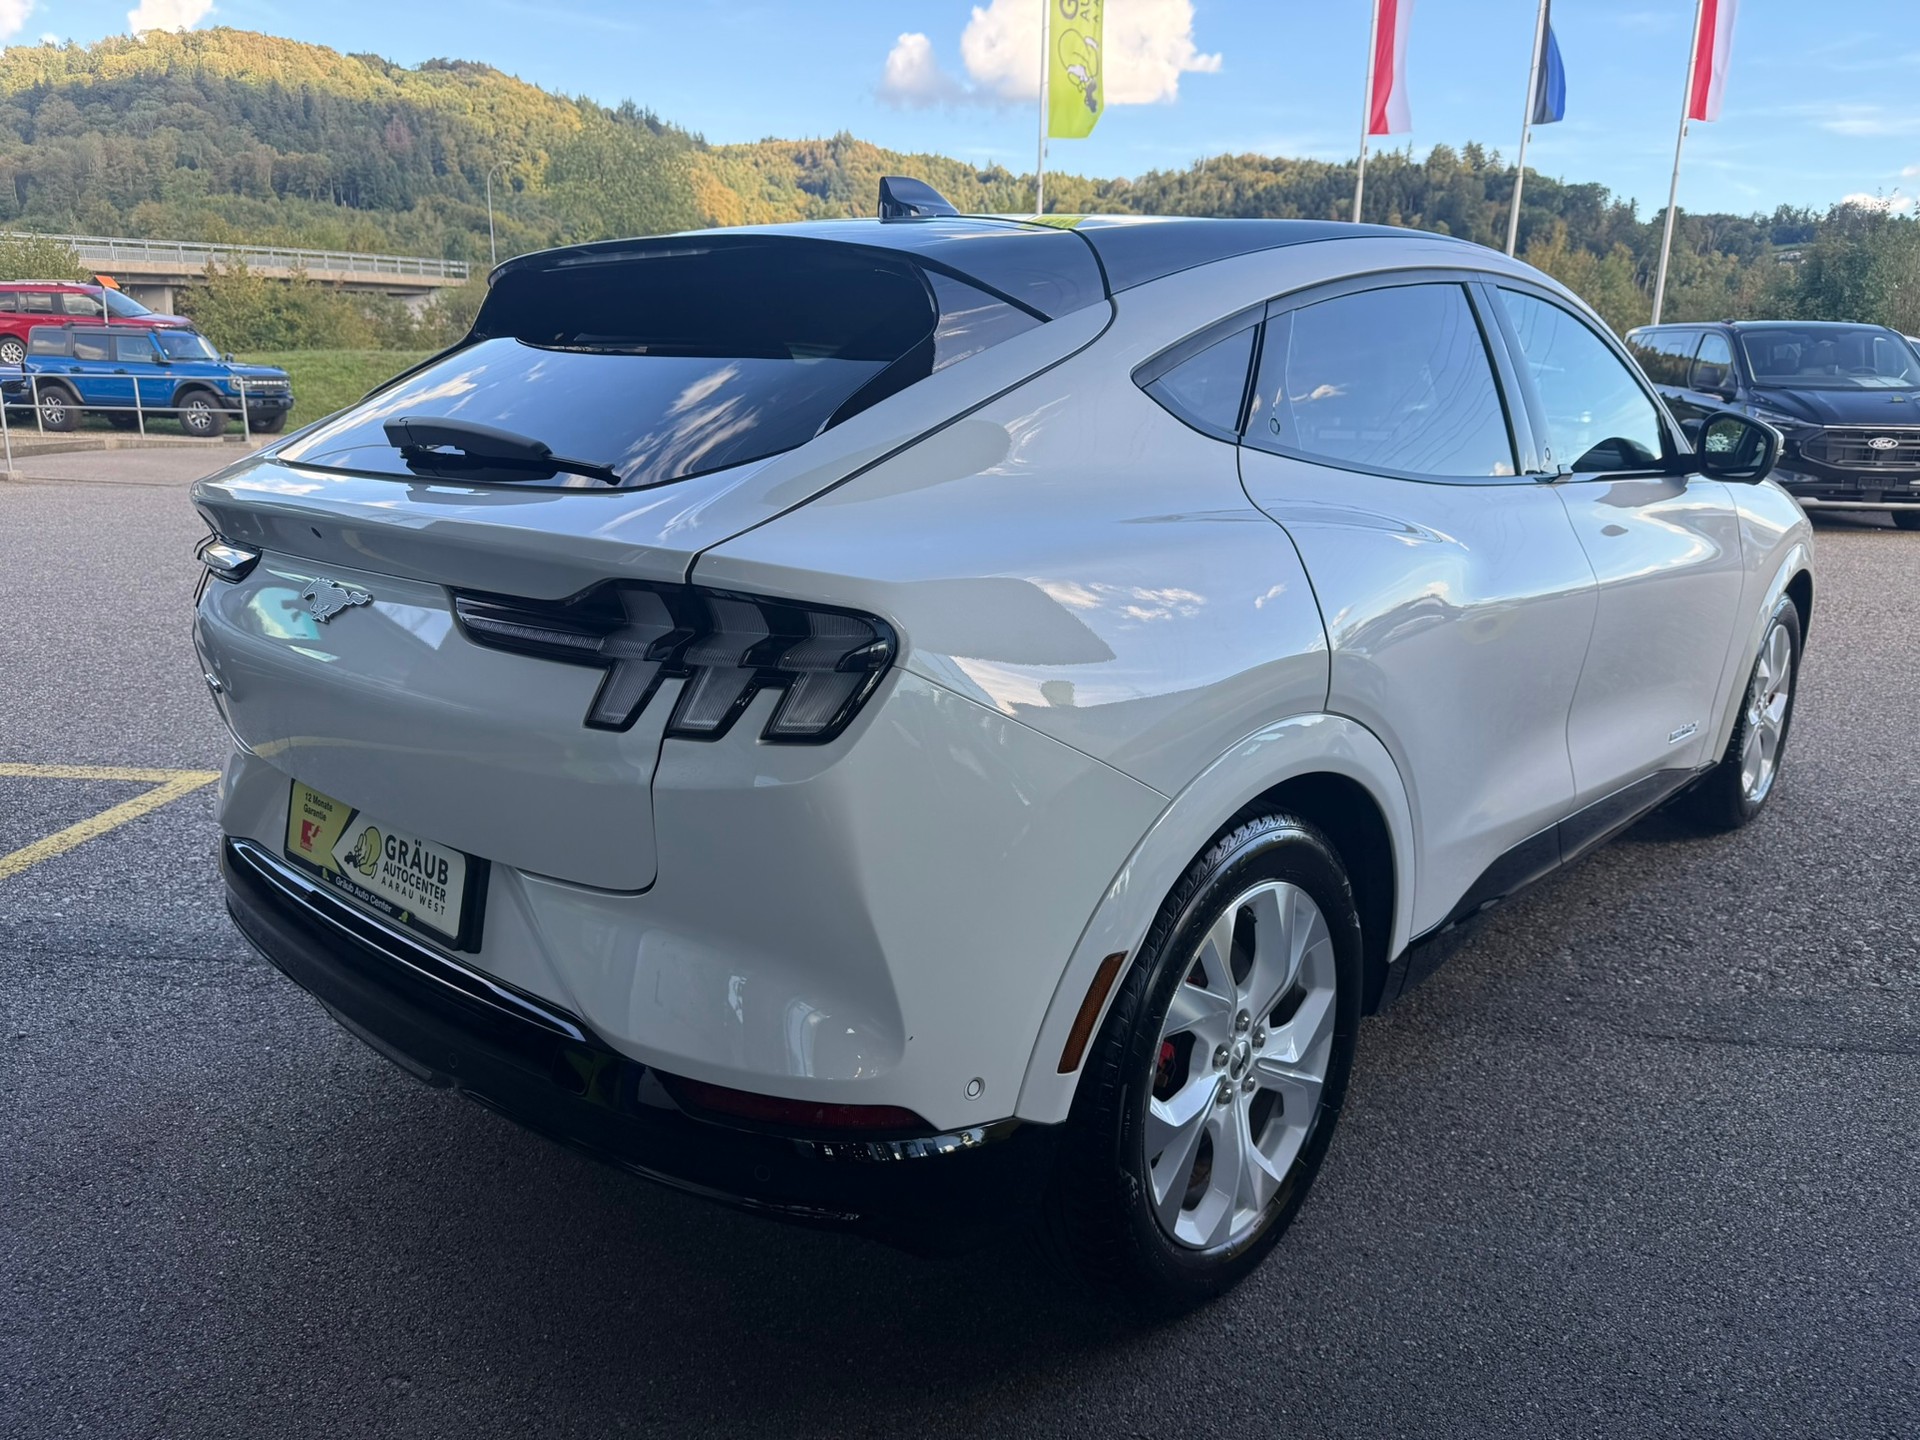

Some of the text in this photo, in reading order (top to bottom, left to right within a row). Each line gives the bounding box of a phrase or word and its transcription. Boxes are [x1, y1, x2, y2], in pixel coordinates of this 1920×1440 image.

[1871, 438, 1895, 449] Ford
[303, 803, 327, 822] Garantie
[305, 792, 333, 812] 12 Monate
[384, 834, 449, 886] GRÄUB
[335, 876, 392, 913] Gräub Auto Center
[381, 876, 445, 915] AARAU WEST
[382, 861, 447, 903] AUTOCENTER
